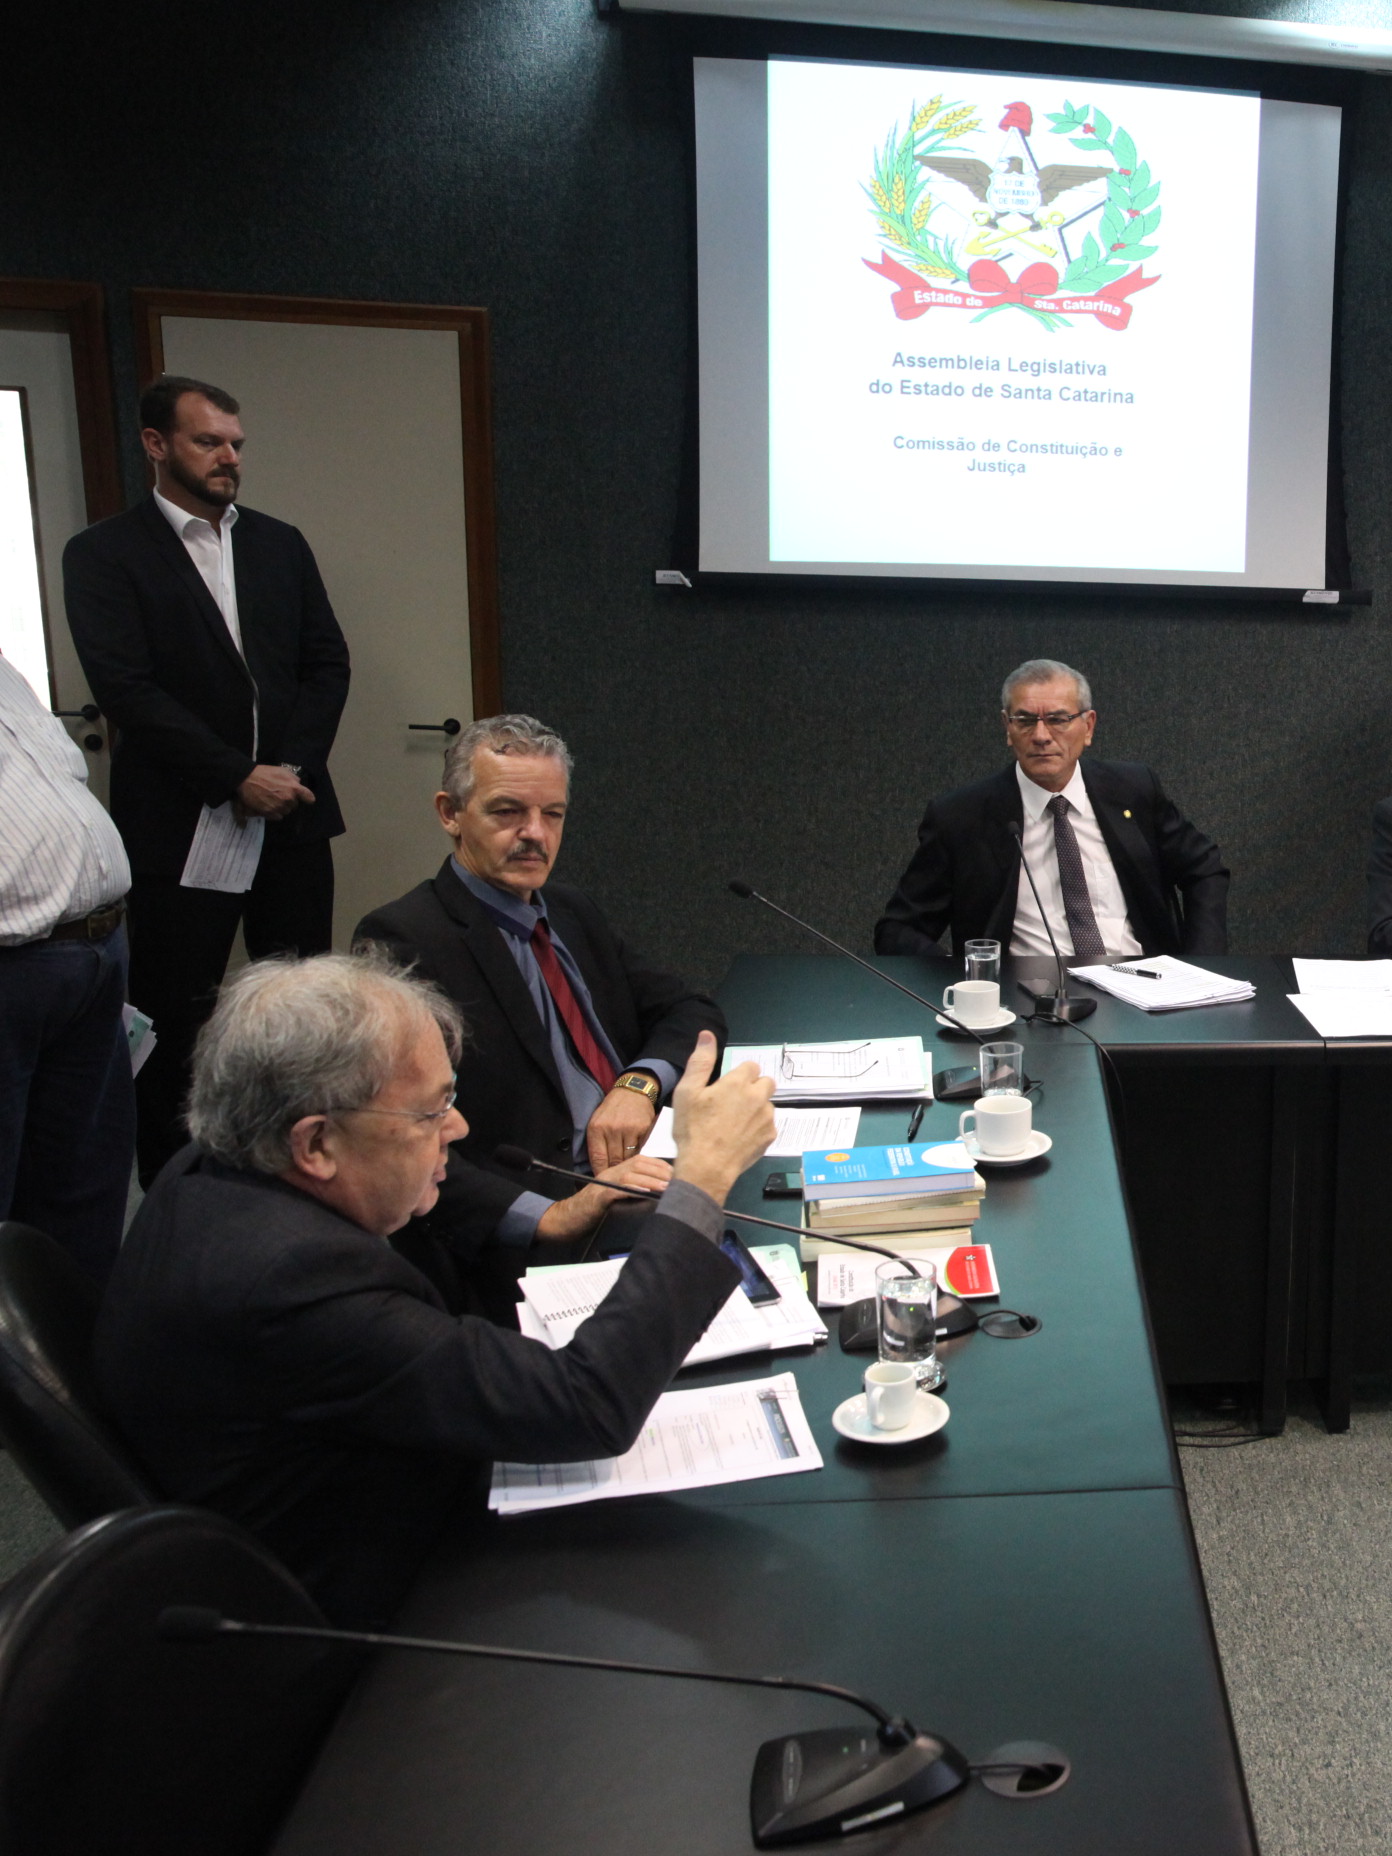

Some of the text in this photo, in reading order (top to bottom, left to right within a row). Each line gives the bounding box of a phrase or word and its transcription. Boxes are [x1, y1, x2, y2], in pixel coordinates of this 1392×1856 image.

[914, 290, 983, 307] Estado de
[1034, 299, 1122, 316] Sta. Catarina
[892, 352, 1107, 377] Assembleia Legislativa
[868, 378, 1135, 404] do Estado de Santa Catarina
[893, 435, 1123, 459] Comissão de Constituição e
[967, 458, 1027, 477] Justiça
